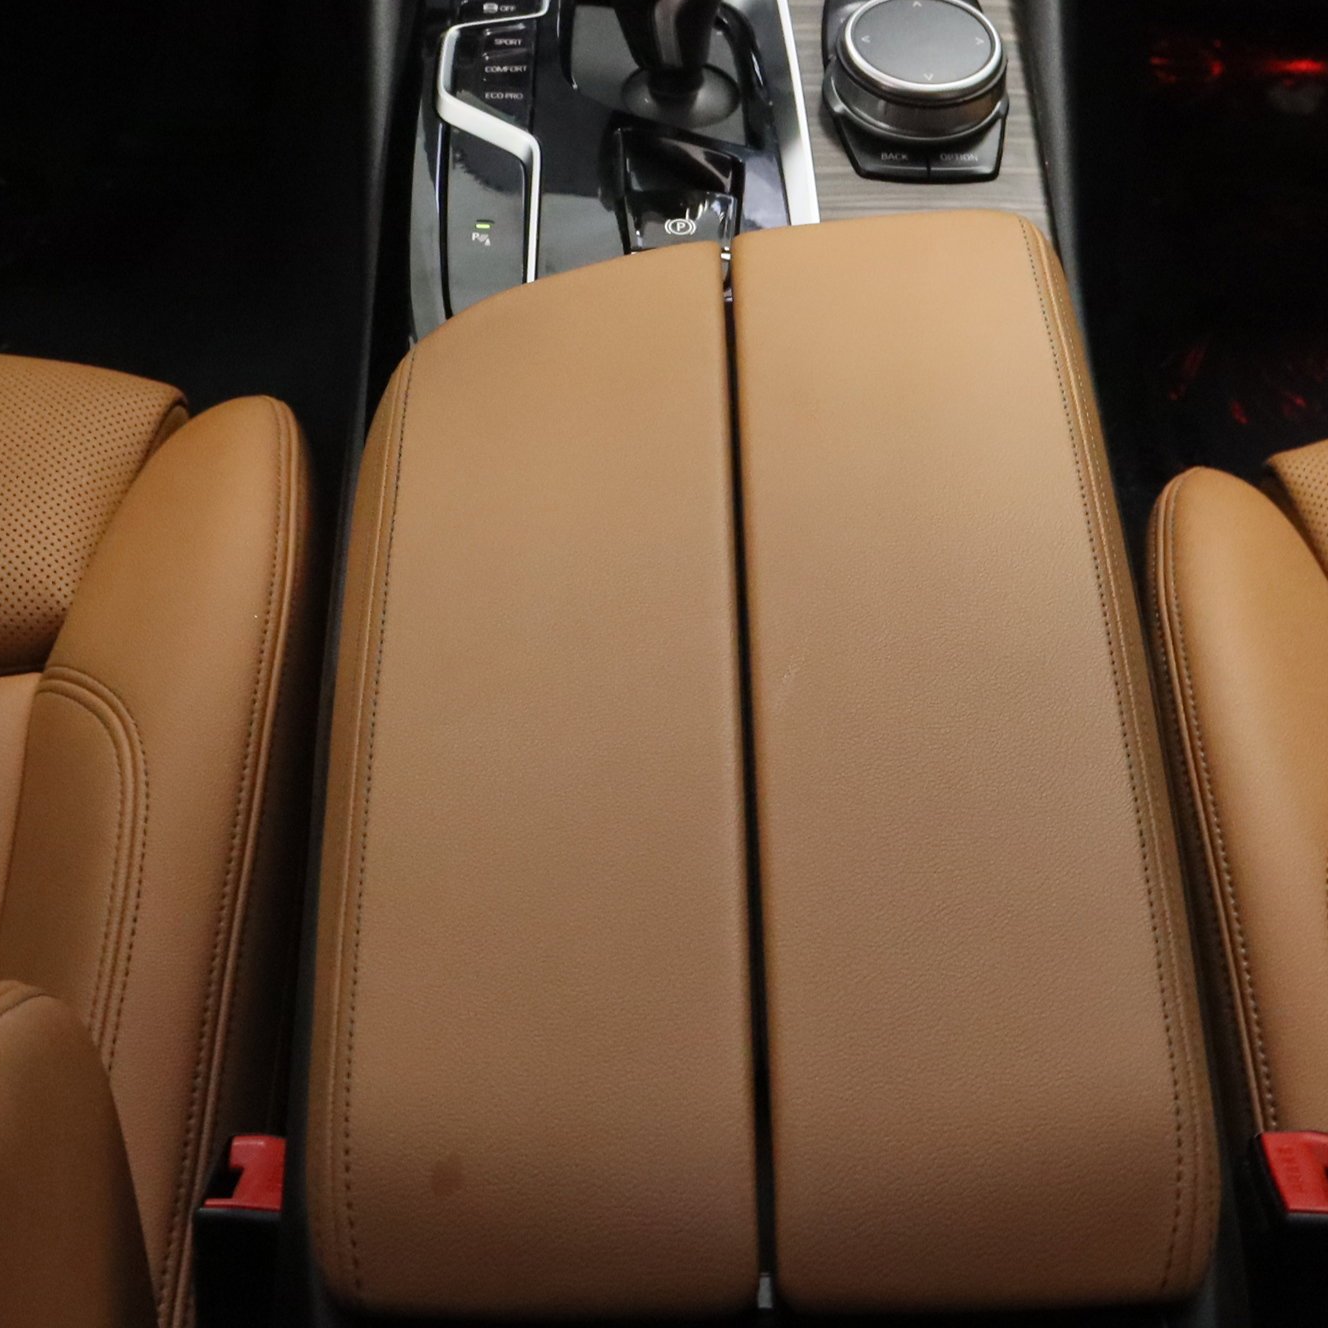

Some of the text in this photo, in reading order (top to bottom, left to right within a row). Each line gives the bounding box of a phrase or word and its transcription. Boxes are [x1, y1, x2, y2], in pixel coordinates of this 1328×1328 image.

[494, 38, 522, 46] SPORT
[484, 65, 527, 73] COMFORT
[504, 92, 523, 100] PRO
[880, 152, 908, 160] BACK
[939, 153, 979, 161] OPTION
[676, 222, 686, 232] P
